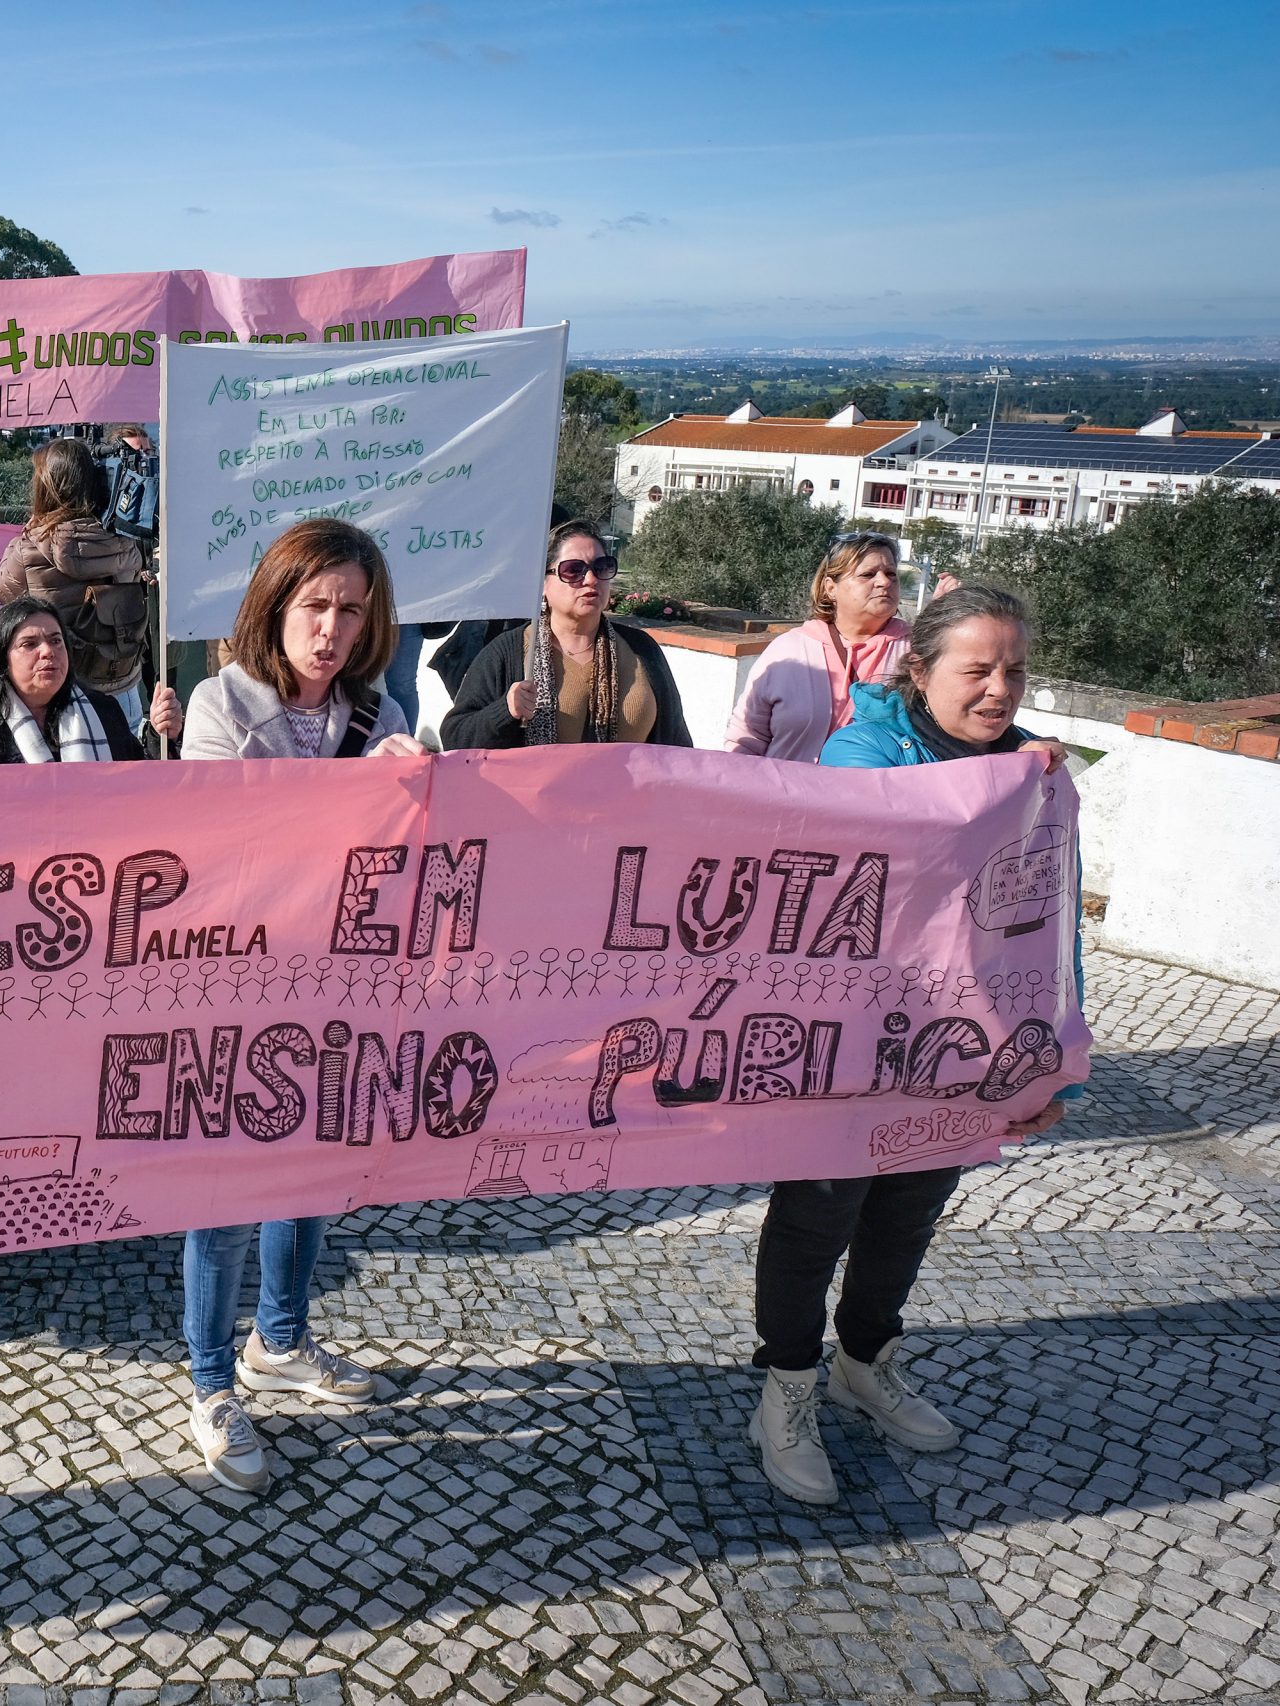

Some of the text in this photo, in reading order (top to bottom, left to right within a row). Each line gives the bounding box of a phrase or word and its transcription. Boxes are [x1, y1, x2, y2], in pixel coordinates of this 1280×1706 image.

[258, 408, 288, 434] EM
[297, 406, 357, 430] LUTA
[252, 475, 346, 503] ORDENADO
[250, 508, 280, 528] DE
[406, 526, 486, 555] JUSTAS
[993, 881, 1006, 890] EM
[141, 924, 268, 964] ALMELA
[330, 838, 488, 960] EM
[602, 846, 890, 960] LUTA
[869, 1107, 996, 1157] RESPECT
[493, 1142, 527, 1151] ESCOLA
